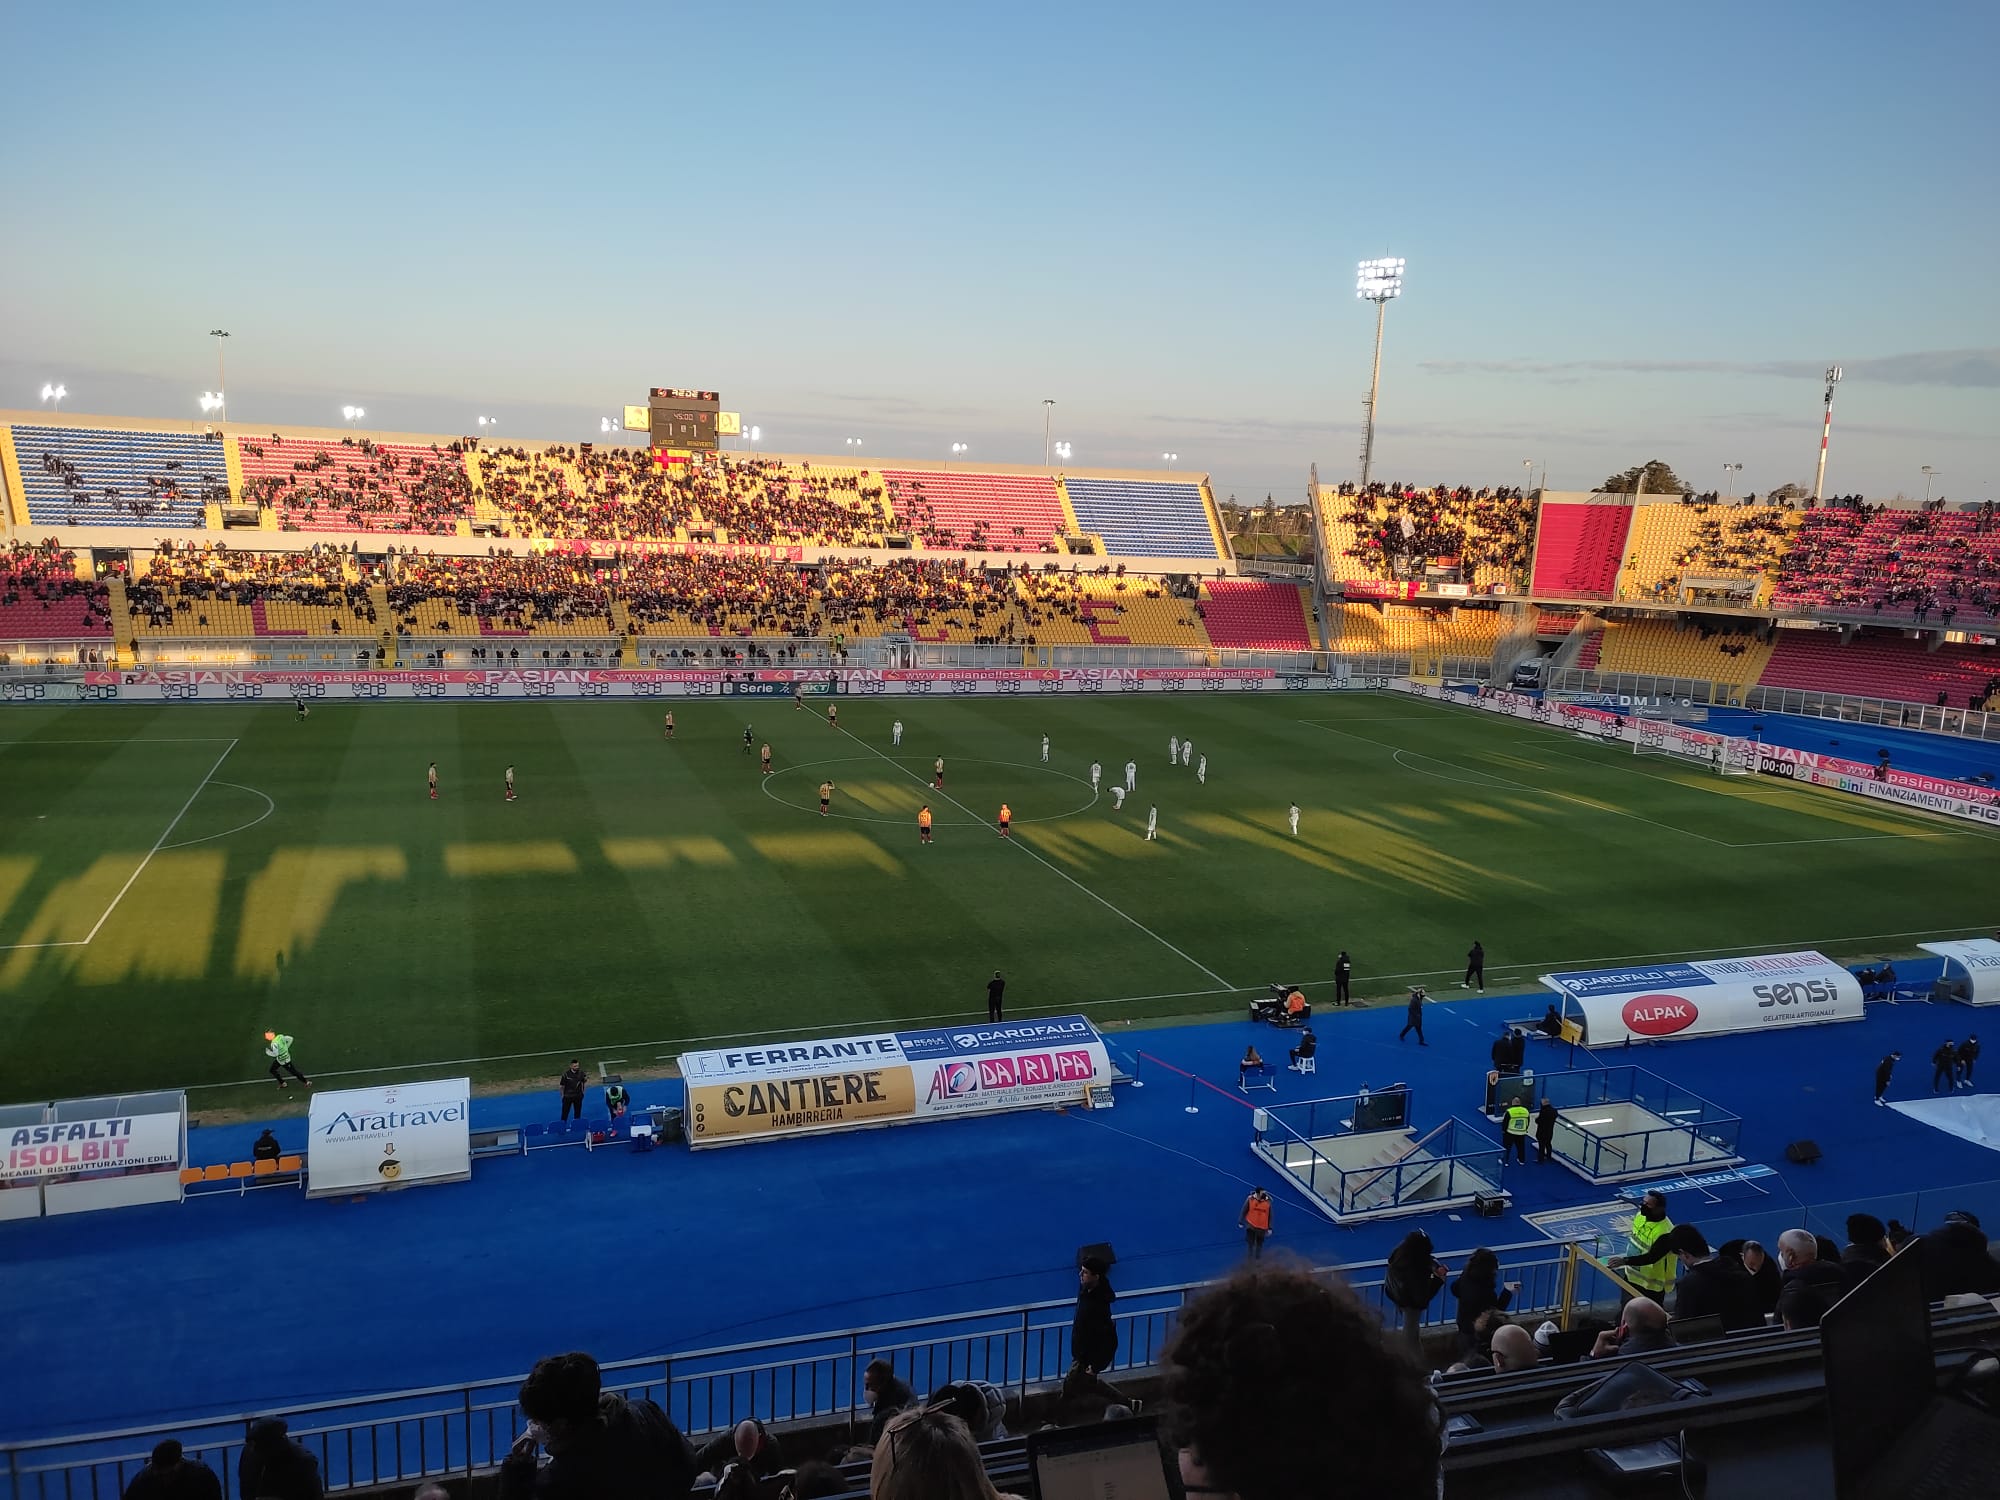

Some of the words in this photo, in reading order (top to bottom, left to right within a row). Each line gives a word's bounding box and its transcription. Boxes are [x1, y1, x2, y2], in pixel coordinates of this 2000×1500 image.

[120, 671, 242, 685] PASIAN
[485, 670, 590, 683] PASIAN
[1059, 669, 1138, 680] PASIAN
[740, 683, 774, 694] Serie
[1495, 690, 1560, 712] PASIN
[1762, 759, 1794, 776] 00:00
[1811, 771, 1863, 793] Bambini
[1868, 783, 1953, 810] FINANZIAMENTI
[1633, 1005, 1687, 1023] ALPAK
[1763, 1013, 1796, 1022] GELATERIA
[1797, 1009, 1836, 1018] ARTIGIANALE
[726, 1038, 897, 1069] FERRANTE
[724, 1071, 887, 1117] CANTIERE
[326, 1102, 465, 1135] Aratravel
[772, 1108, 843, 1127] HAMBIRRERIA
[11, 1119, 132, 1146] ASFALTI
[325, 1131, 394, 1144] WWW.ARATRAVEL.IT
[9, 1139, 130, 1169] ISOLBIT
[47, 1157, 145, 1174] RISTRUTTURAZIONI
[147, 1155, 173, 1163] EDILI
[1642, 1172, 1750, 1193] www.uslecce.it
